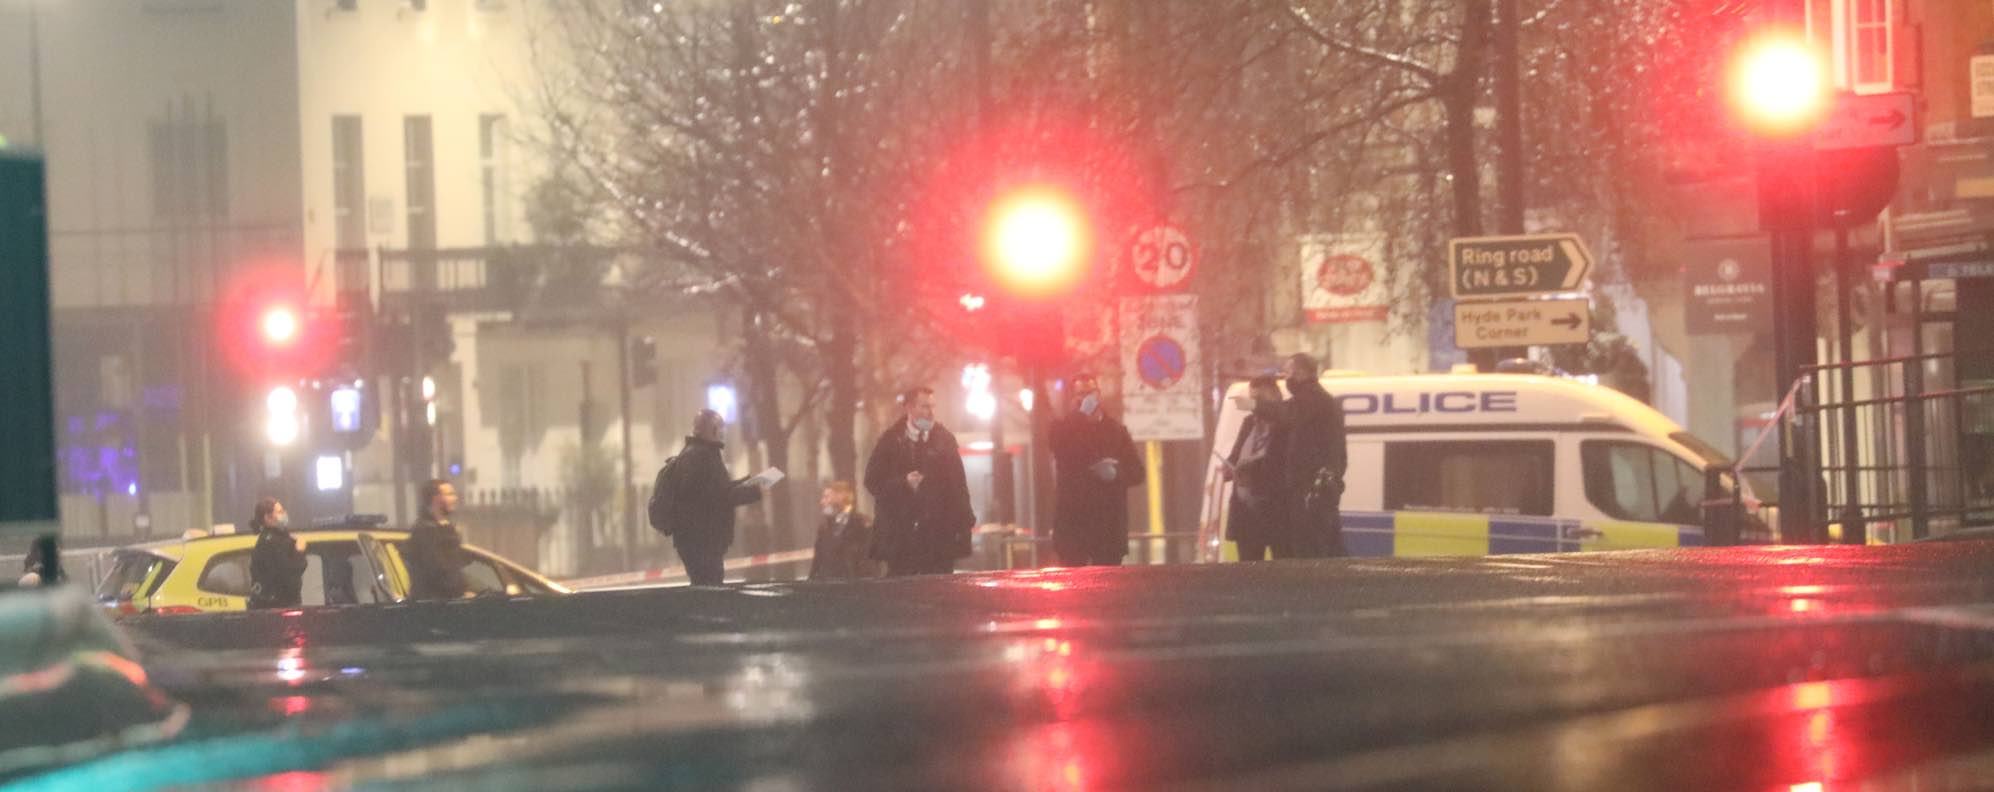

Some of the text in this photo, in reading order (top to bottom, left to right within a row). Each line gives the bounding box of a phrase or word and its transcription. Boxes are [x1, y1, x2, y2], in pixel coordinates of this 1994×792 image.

[1138, 242, 1187, 271] 20
[1462, 244, 1554, 267] Ring road
[1462, 265, 1538, 290] (N & S)
[1461, 307, 1541, 325] Hyde Park
[1475, 326, 1528, 340] Corner
[1335, 390, 1517, 414] OLICE
